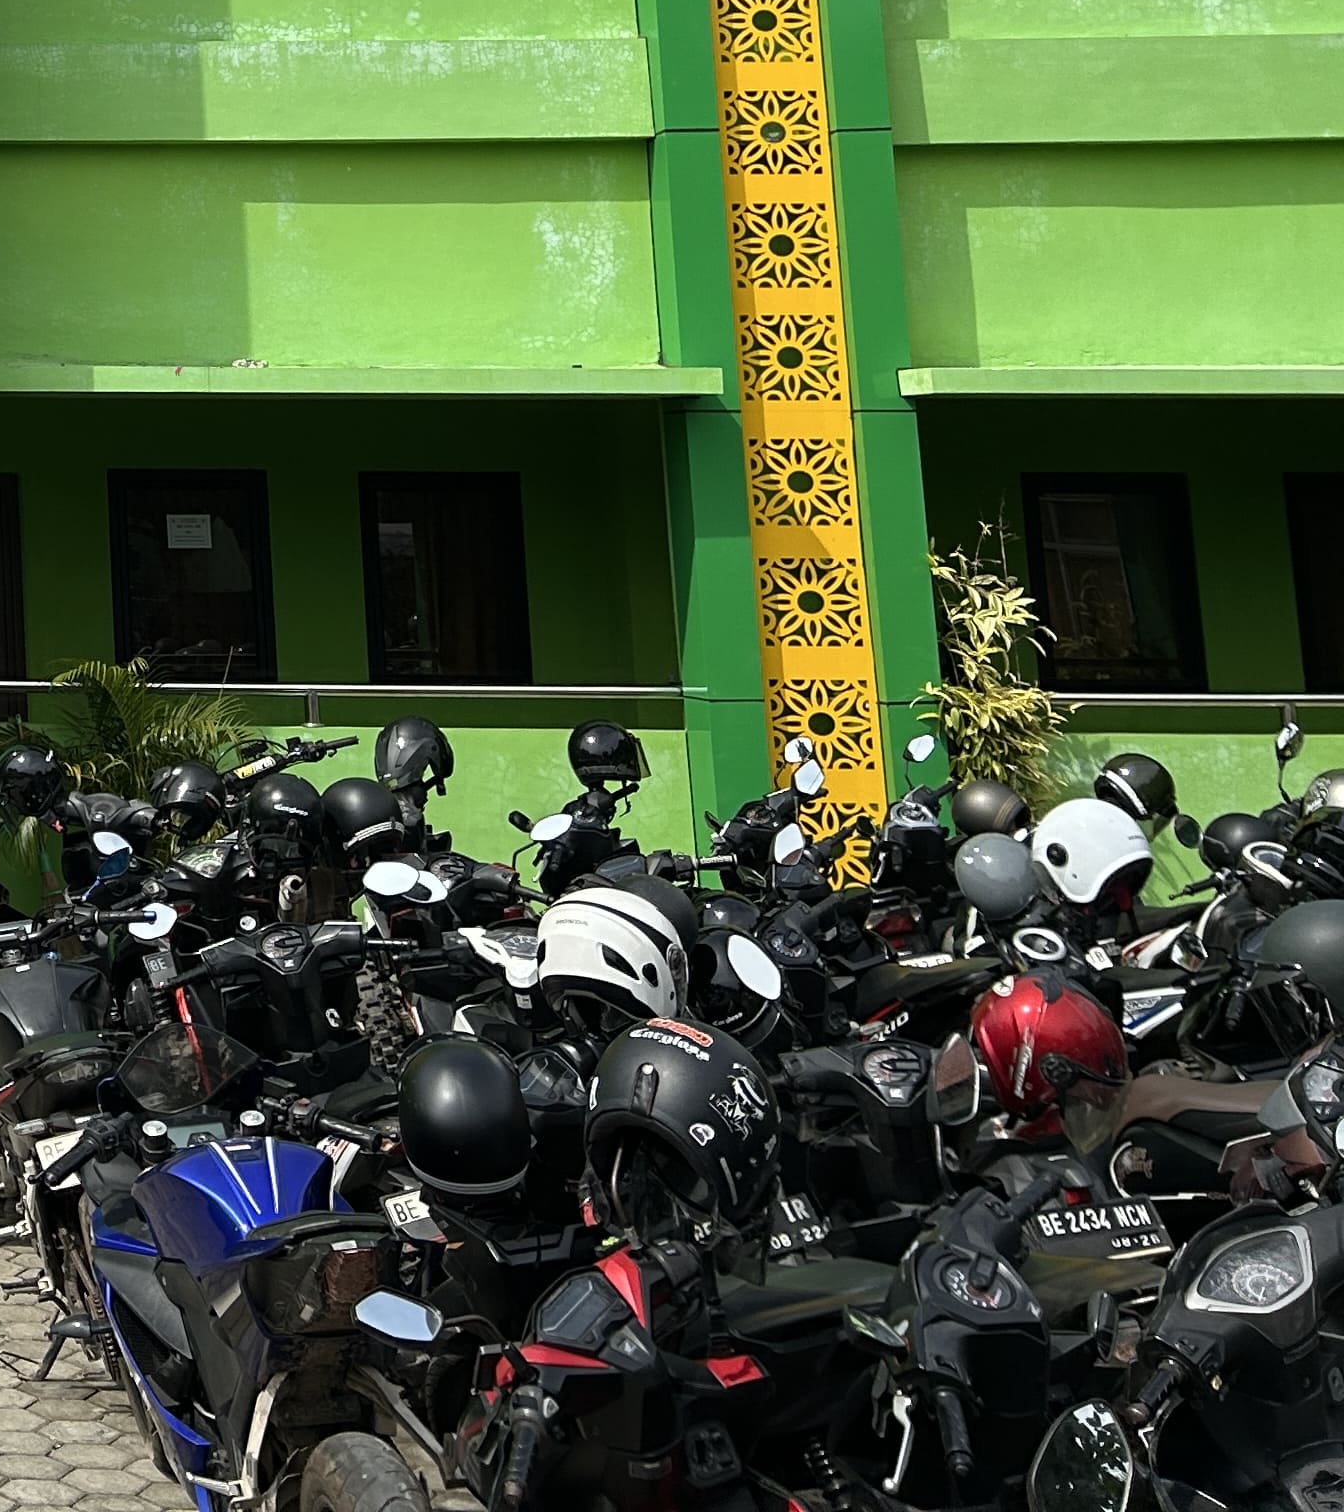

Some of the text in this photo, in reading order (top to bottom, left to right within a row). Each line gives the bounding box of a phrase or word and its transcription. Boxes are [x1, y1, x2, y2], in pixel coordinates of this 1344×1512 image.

[148, 958, 167, 972] BE
[629, 1028, 710, 1062] Cargloss
[43, 1141, 65, 1162] BE
[393, 1199, 420, 1223] BE
[1037, 1204, 1152, 1237] BE 2434 NCN
